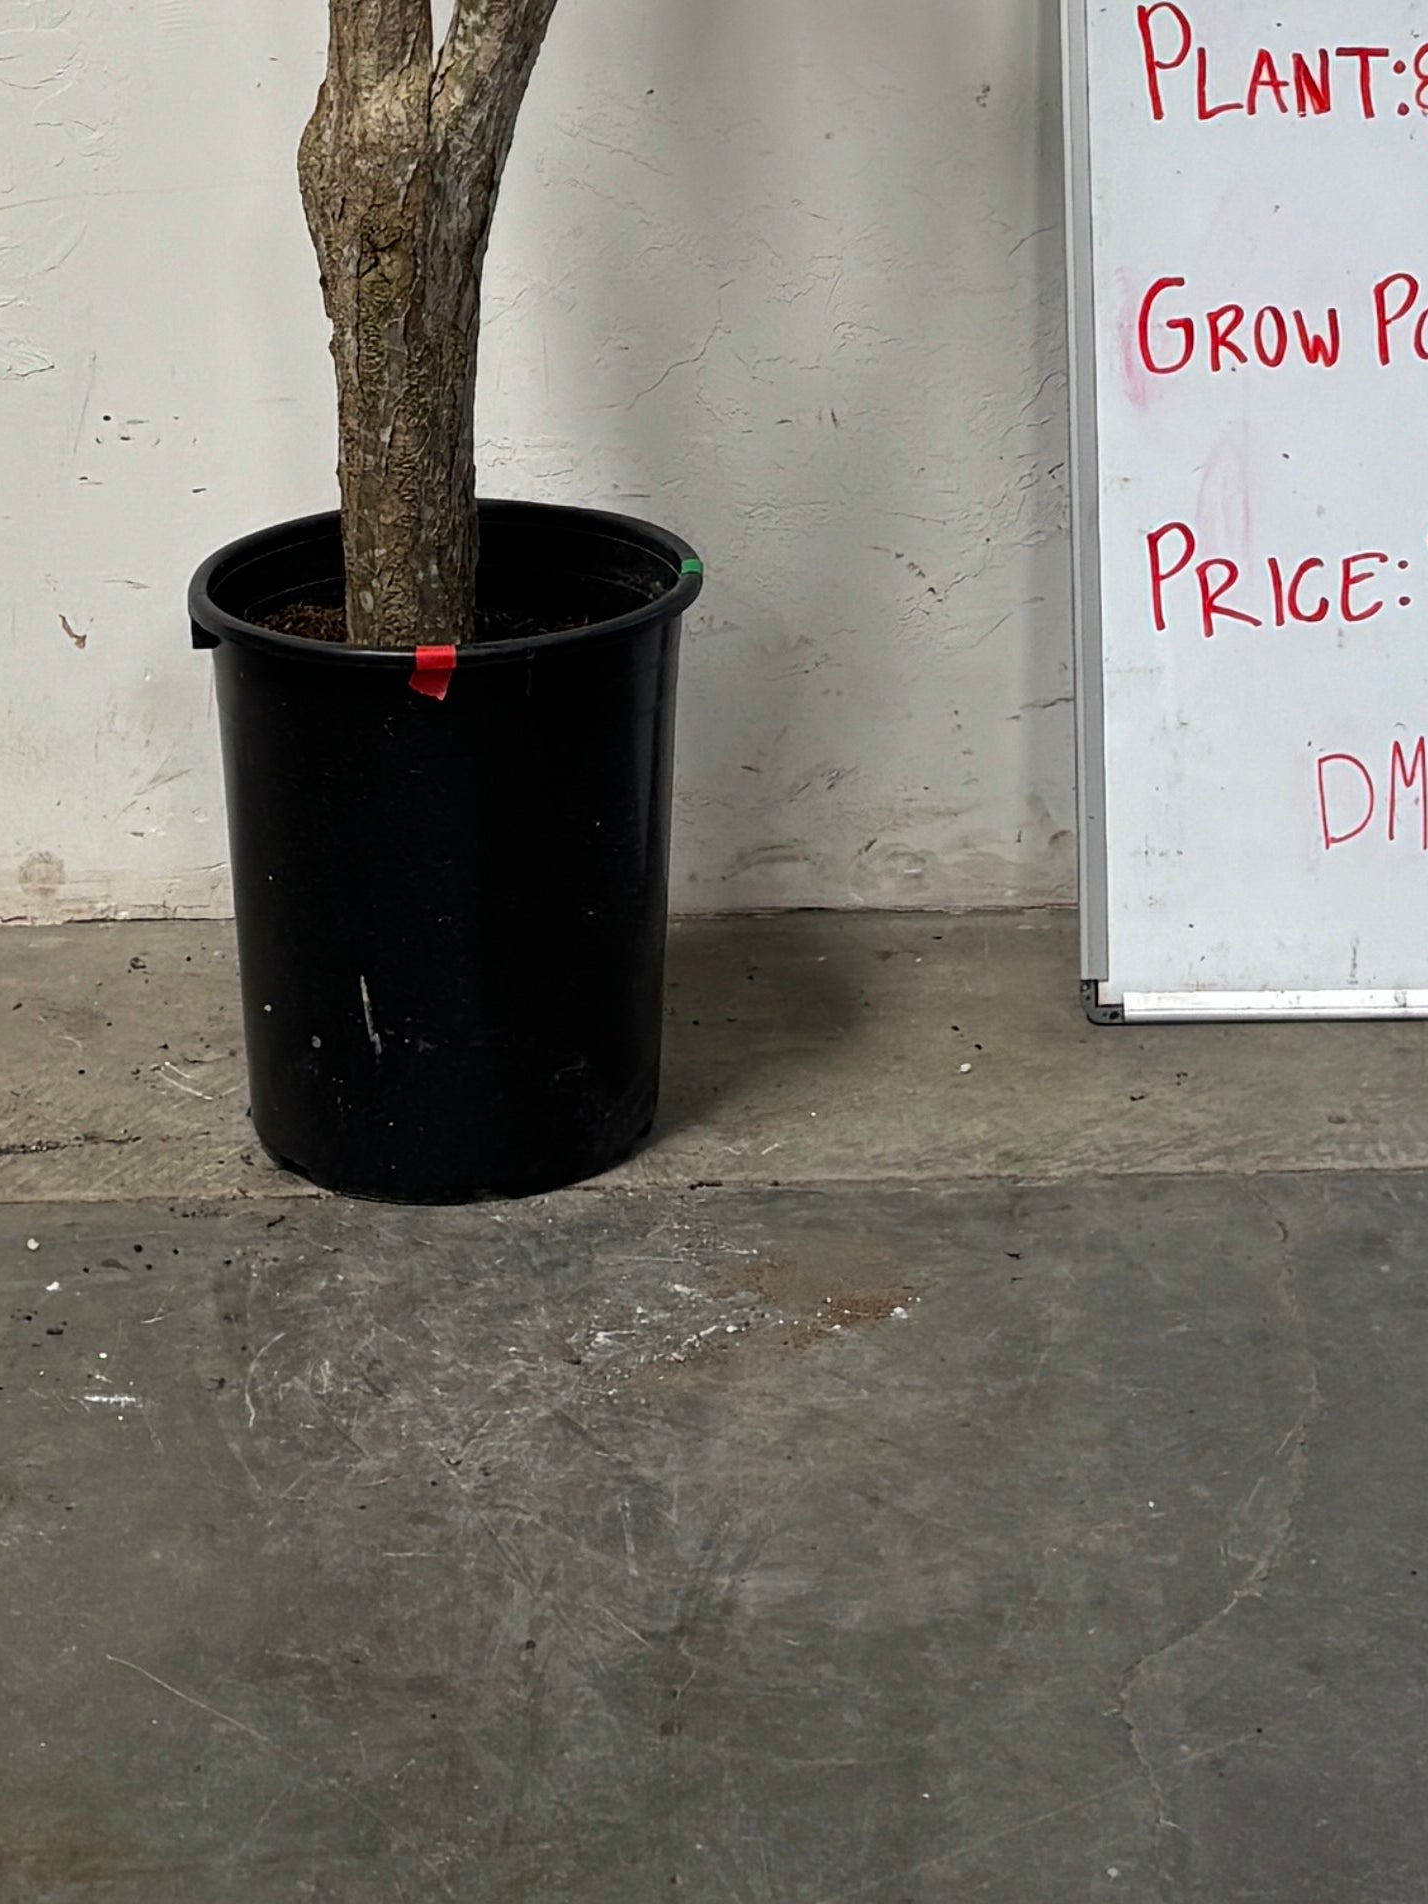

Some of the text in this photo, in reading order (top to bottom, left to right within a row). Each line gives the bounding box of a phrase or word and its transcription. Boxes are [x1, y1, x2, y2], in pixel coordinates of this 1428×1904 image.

[1135, 1, 1411, 122] PLANT:
[1136, 275, 1341, 376] GROW
[1146, 521, 1412, 639] PRICE:
